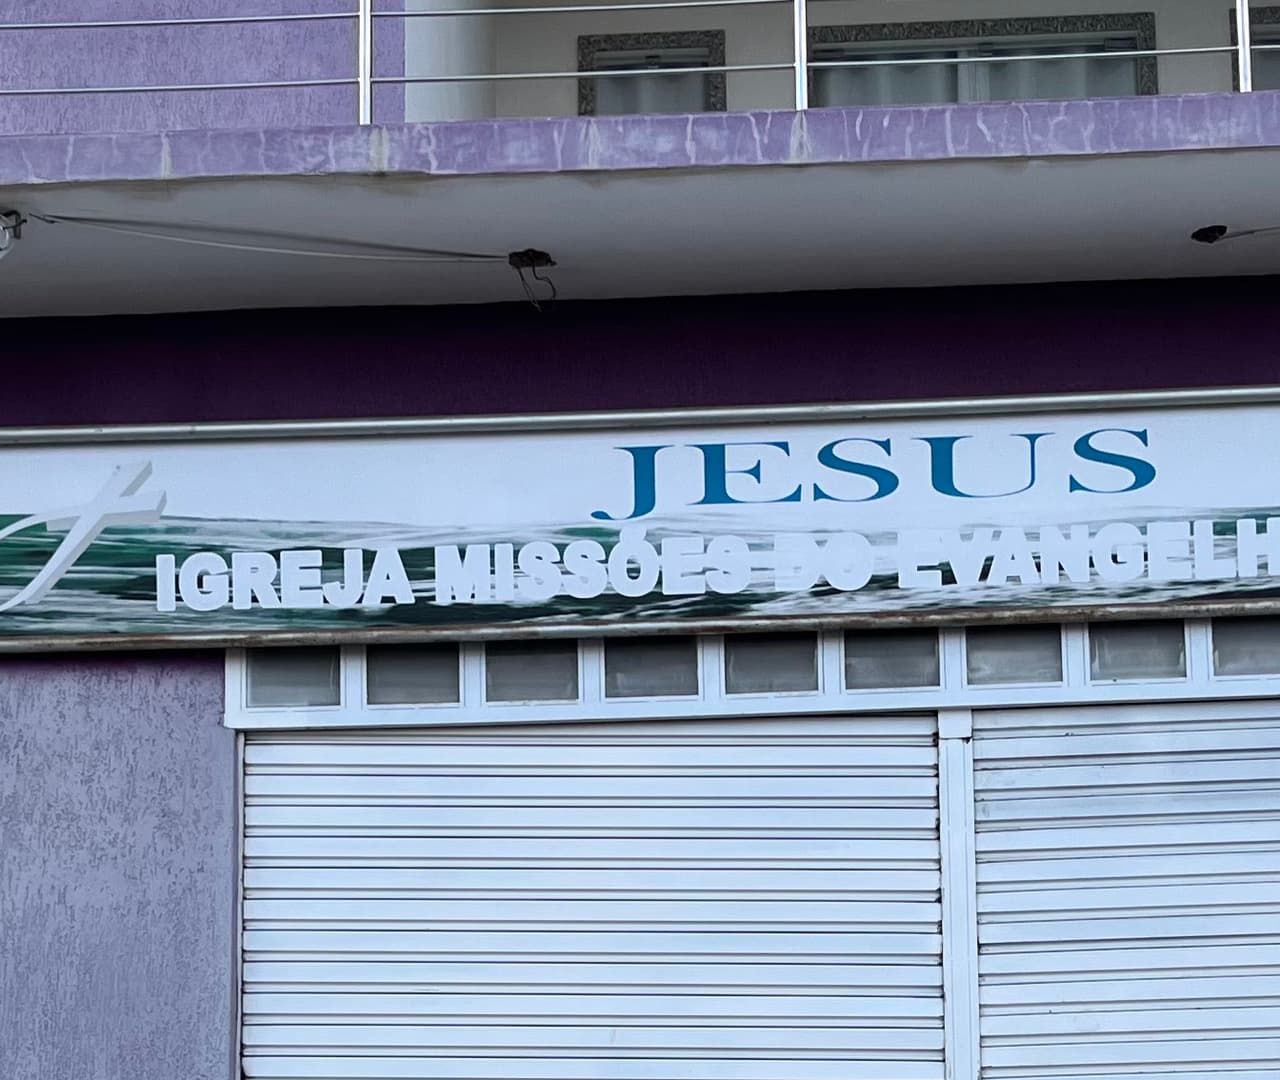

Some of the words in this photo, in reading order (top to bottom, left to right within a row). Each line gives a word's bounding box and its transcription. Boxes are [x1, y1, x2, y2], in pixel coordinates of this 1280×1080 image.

[590, 428, 1157, 522] JESUS
[155, 546, 417, 613] IGREJA
[773, 530, 873, 592] DO
